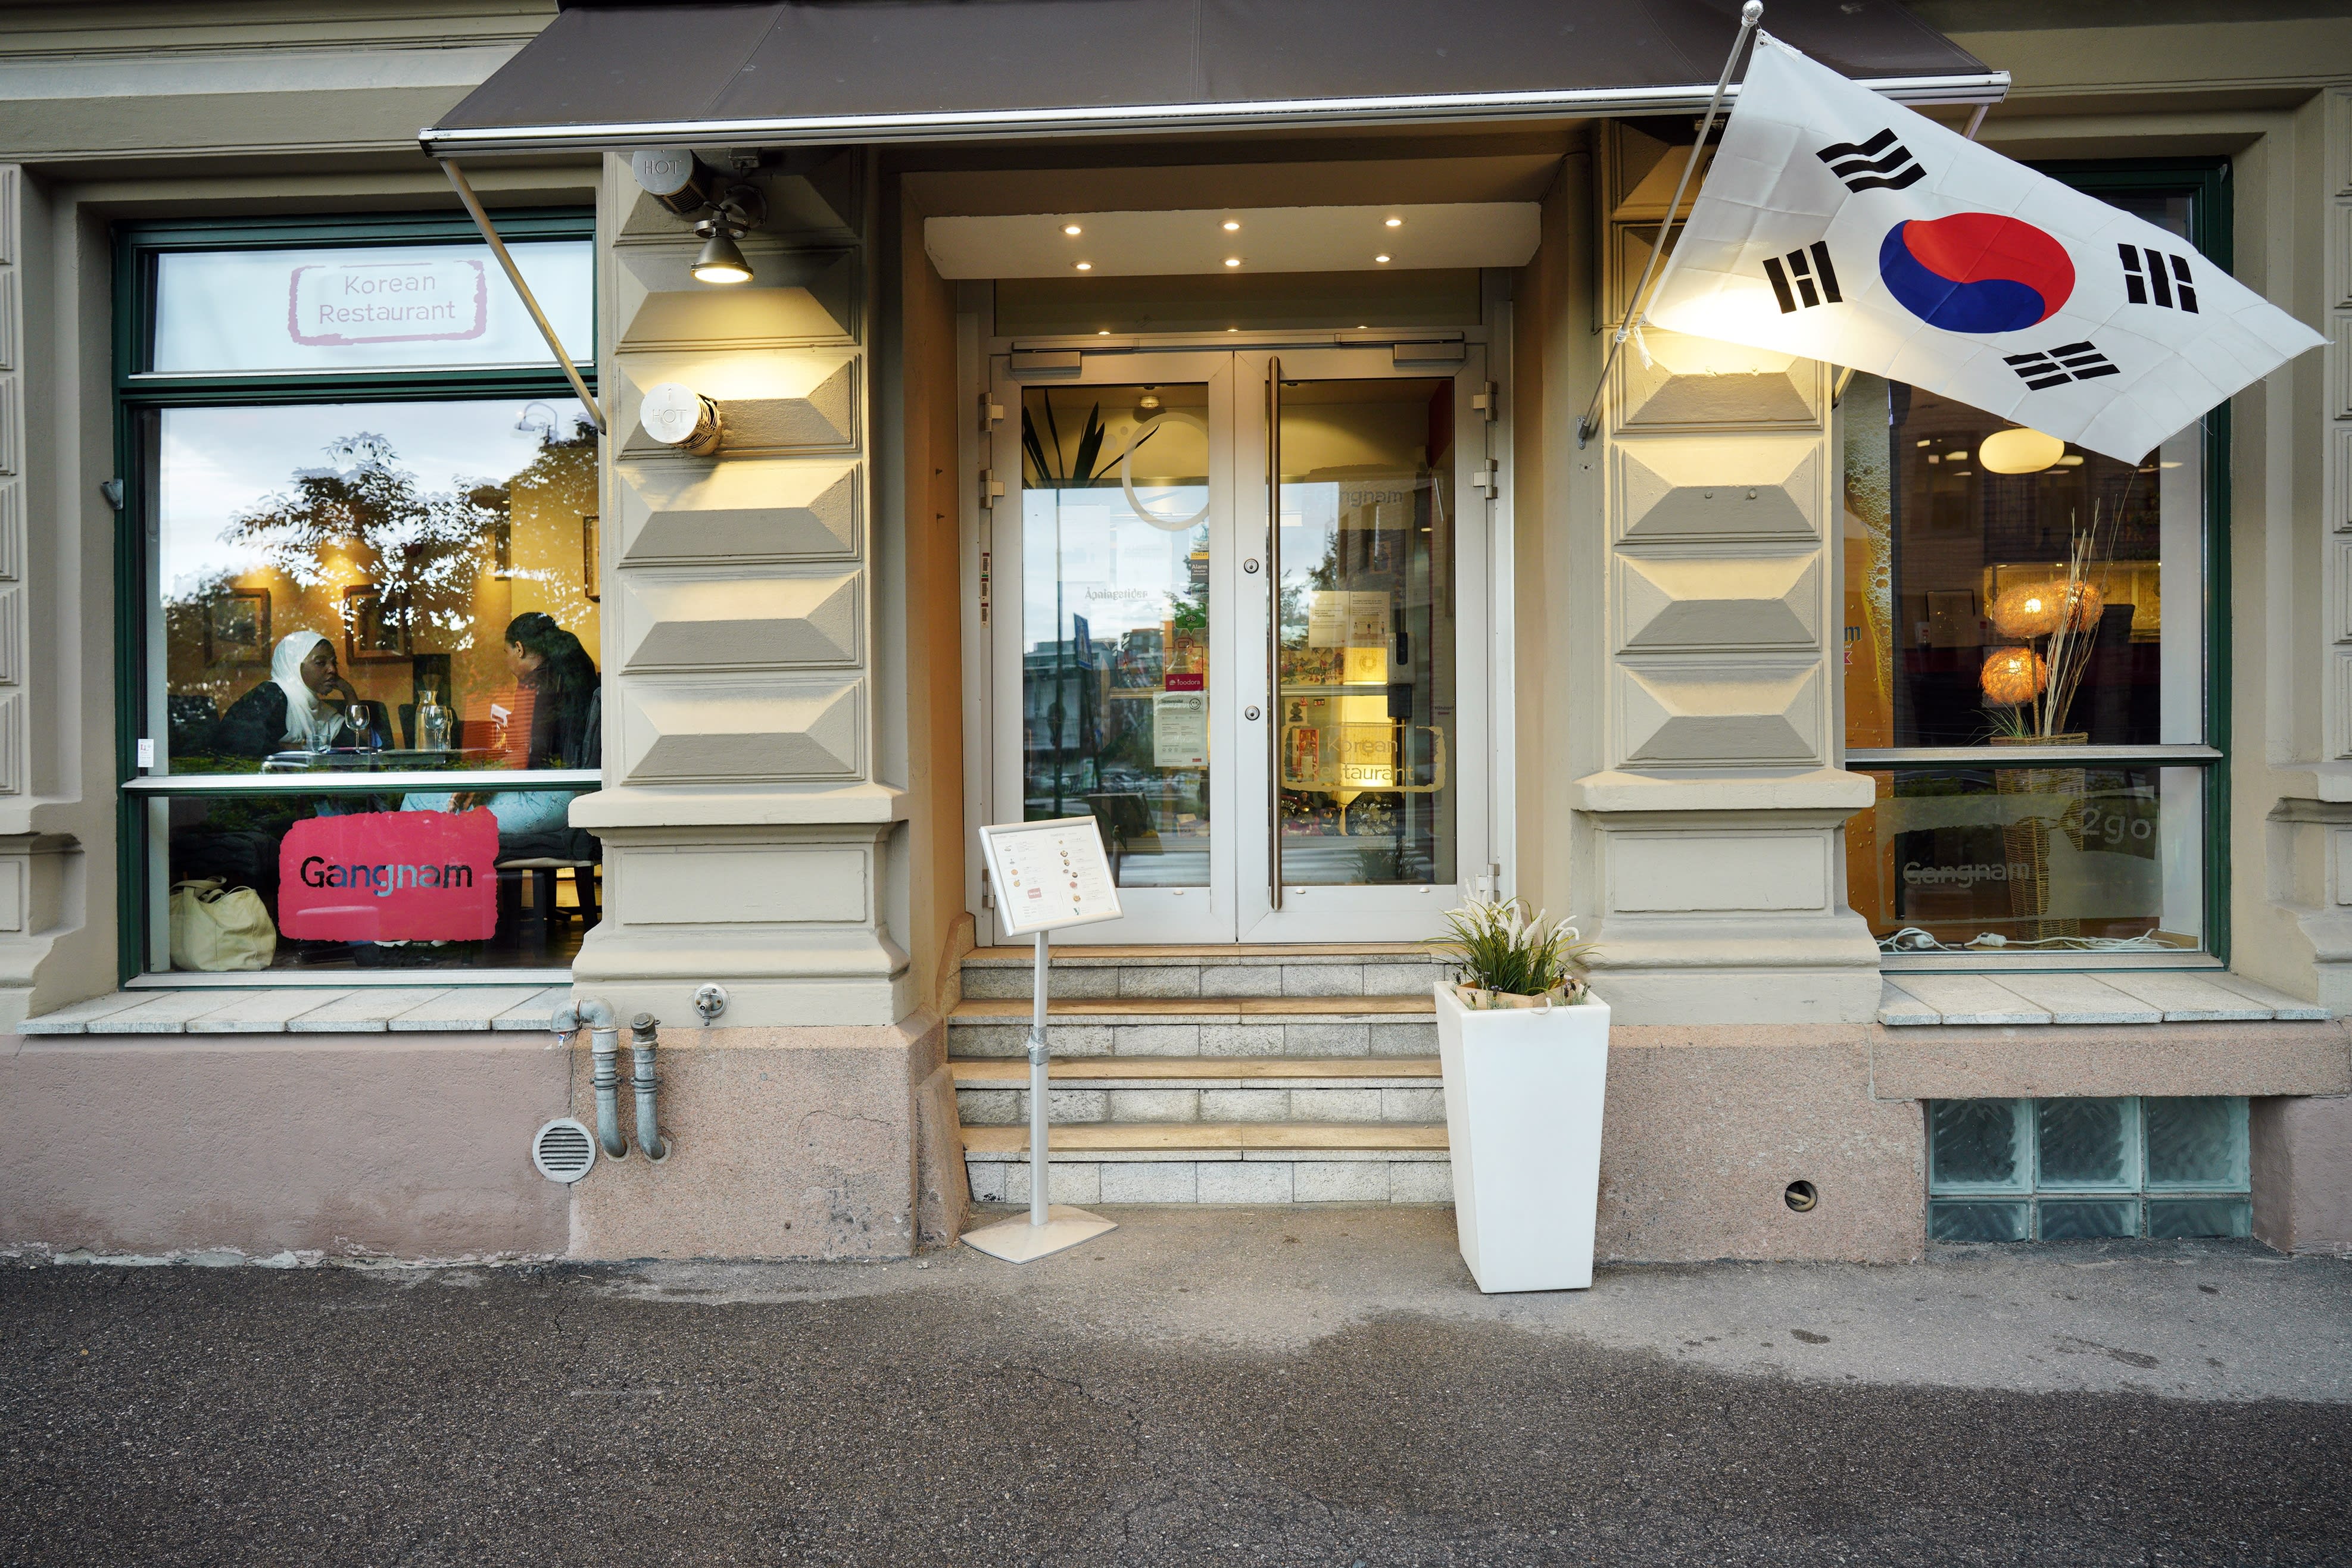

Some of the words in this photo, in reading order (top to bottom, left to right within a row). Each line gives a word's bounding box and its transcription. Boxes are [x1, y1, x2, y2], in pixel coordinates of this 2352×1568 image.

[644, 160, 681, 175] HOT
[345, 276, 435, 295] Korean
[319, 301, 456, 324] Restaurant
[652, 409, 687, 424] HOT
[1327, 736, 1398, 753] Korean
[2080, 807, 2151, 844] 2go
[300, 856, 472, 897] Gangnam
[1903, 861, 2029, 888] Gangnam
